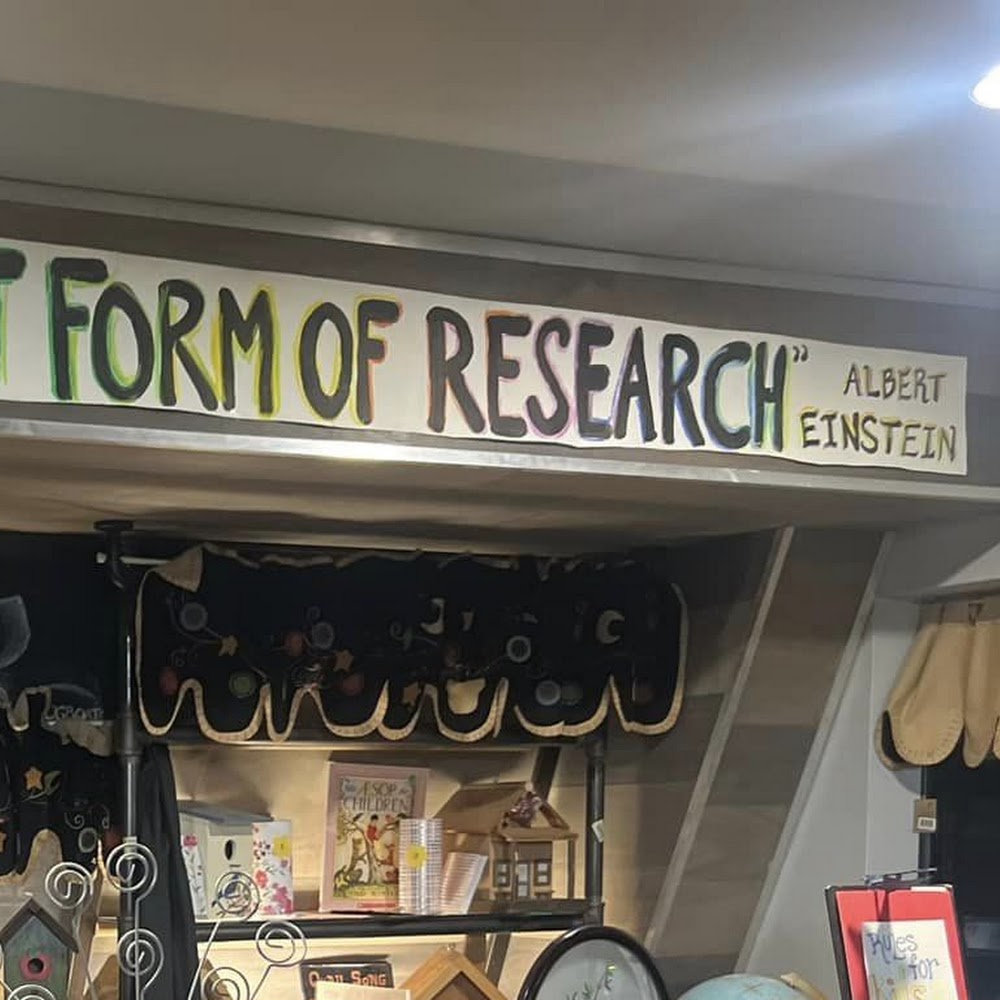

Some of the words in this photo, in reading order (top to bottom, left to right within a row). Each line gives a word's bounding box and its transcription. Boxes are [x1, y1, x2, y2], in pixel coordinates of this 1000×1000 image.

[50, 256, 279, 418] FORM
[298, 297, 402, 426] OF
[842, 362, 947, 403] ALBERT
[800, 407, 956, 462] EINSTEIN
[343, 797, 409, 812] CHILDREN
